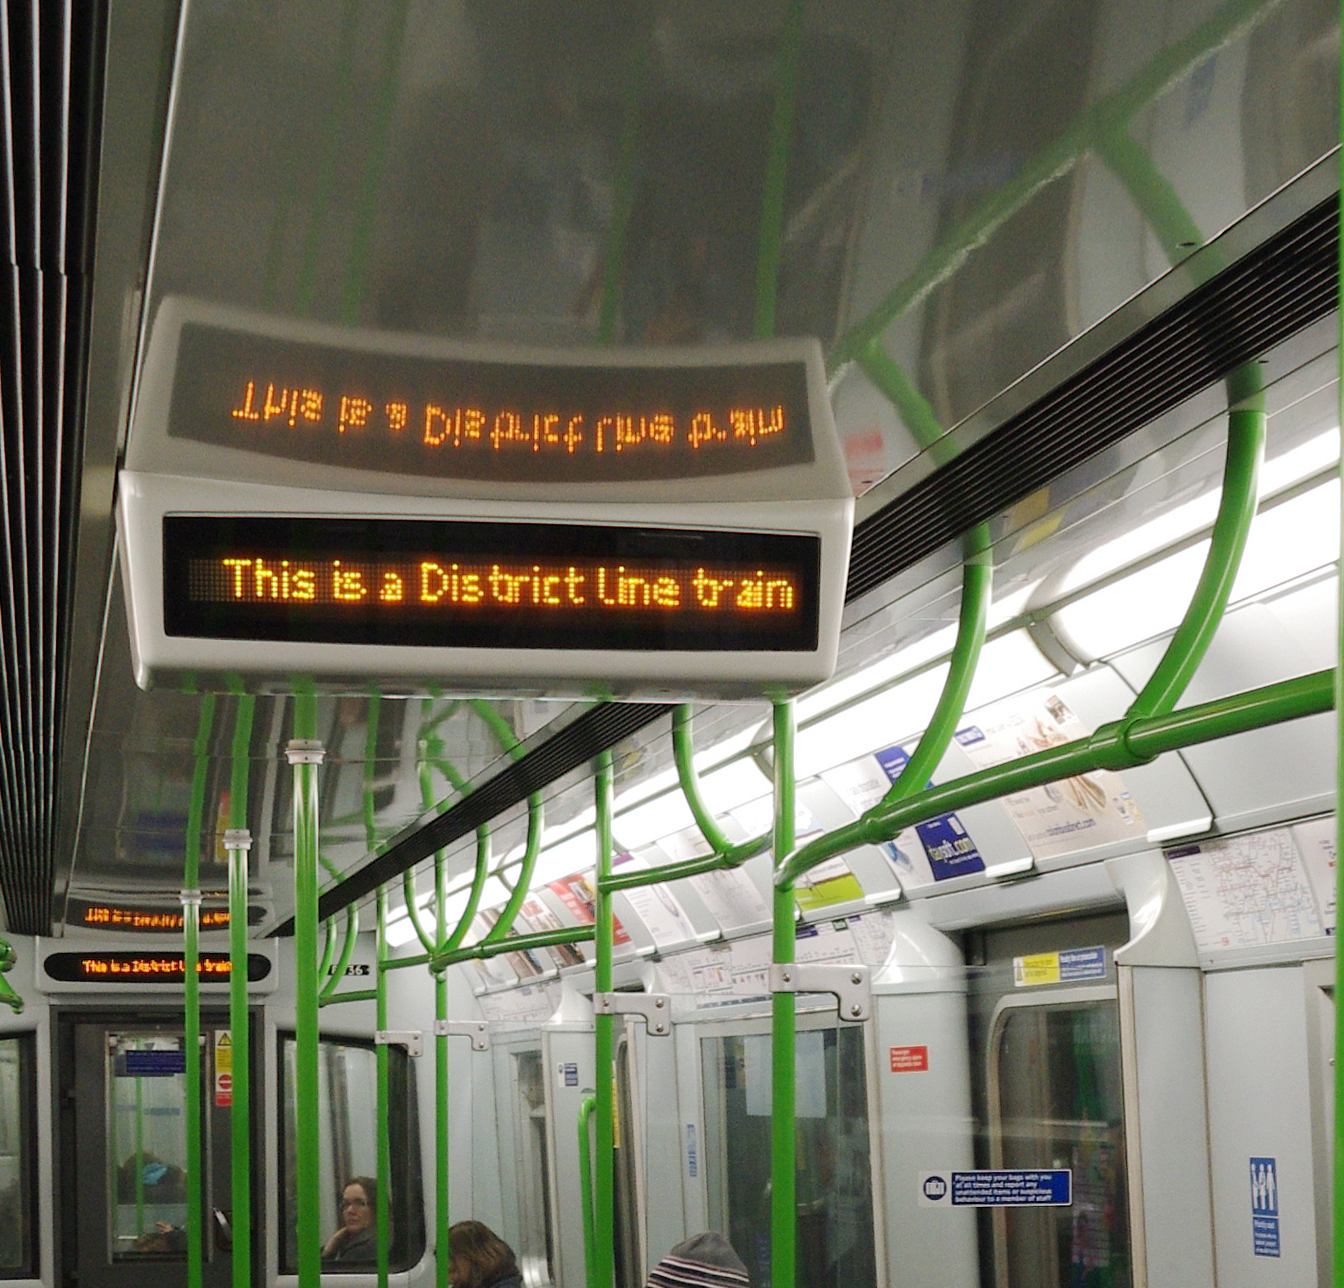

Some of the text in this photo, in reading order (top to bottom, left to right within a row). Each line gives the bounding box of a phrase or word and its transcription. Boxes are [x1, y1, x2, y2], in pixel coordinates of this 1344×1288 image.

[222, 558, 315, 600] This
[333, 559, 368, 600] is
[379, 572, 403, 601] a
[421, 562, 585, 603] District
[692, 567, 794, 609] train
